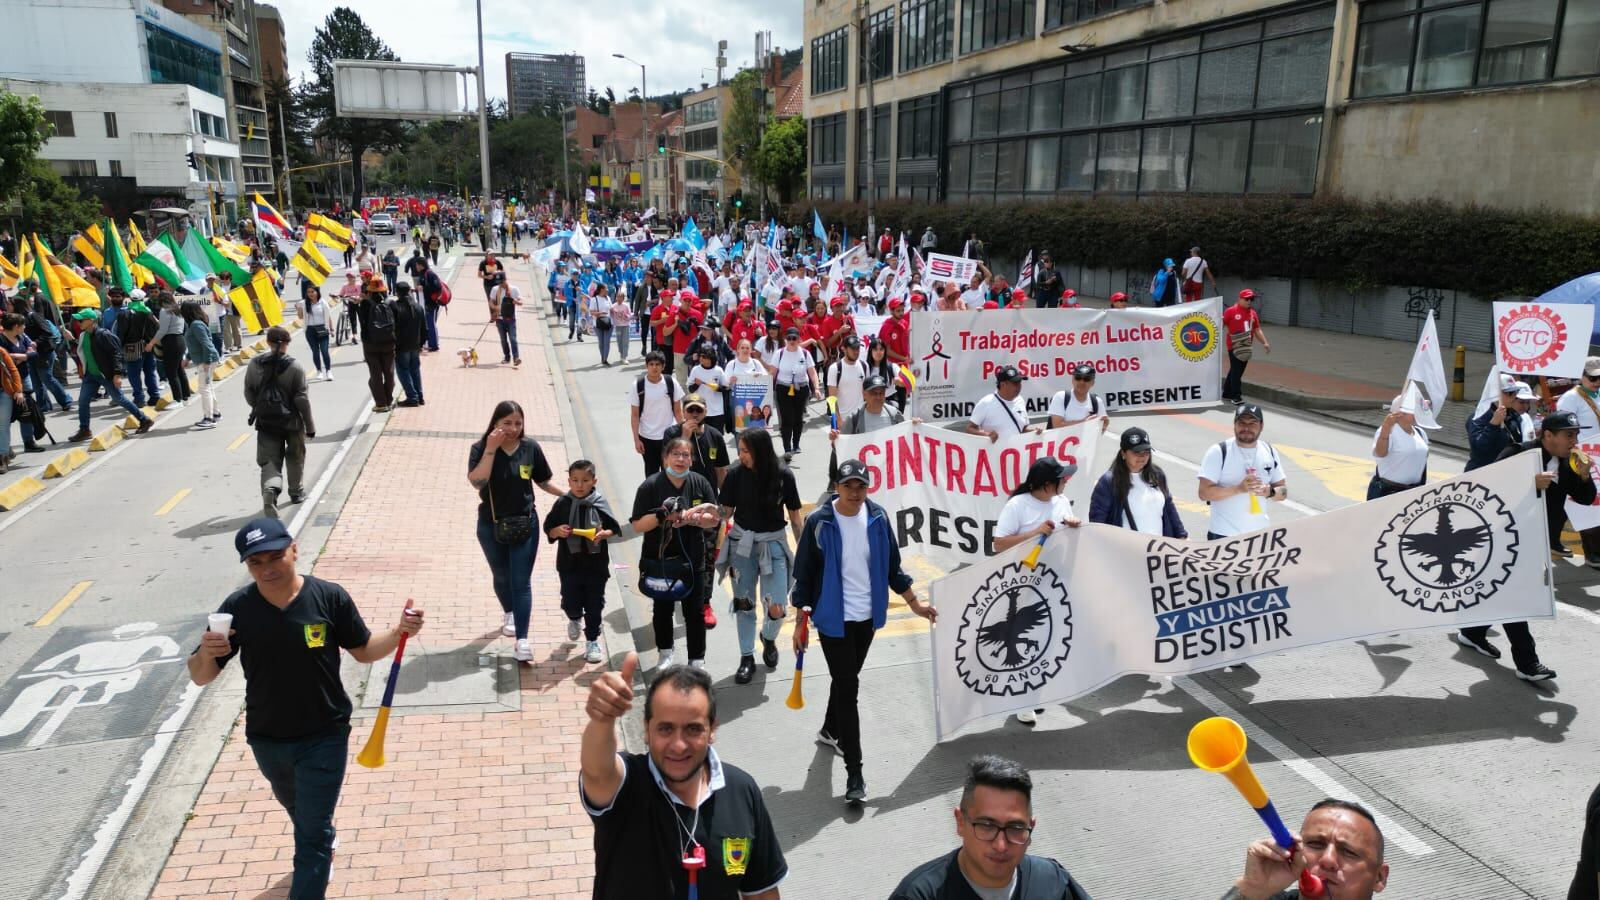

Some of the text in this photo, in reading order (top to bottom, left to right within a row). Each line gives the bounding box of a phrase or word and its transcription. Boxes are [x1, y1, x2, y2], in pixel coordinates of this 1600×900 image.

[958, 323, 1164, 354] Trabajadores en Lucha
[1182, 330, 1208, 344] CTC
[1507, 329, 1550, 346] CTC
[1018, 359, 1049, 378] Sus
[1106, 385, 1202, 408] PRESENTE
[858, 432, 1080, 496] SINTRAOTIS
[1402, 493, 1486, 525] SINTRAOTIS
[896, 506, 1000, 557] RESE
[1146, 527, 1288, 561] INSISTIR
[1146, 547, 1302, 584] PERSISTIR
[975, 575, 1042, 617] SINTRAOTIS
[1151, 568, 1281, 615] RESISTIR
[1413, 580, 1485, 600] 60 AÑOS
[1163, 592, 1285, 633] Y NUNCA
[1154, 611, 1293, 664] DESISTIR
[984, 659, 1050, 684] 60 AÑOS
